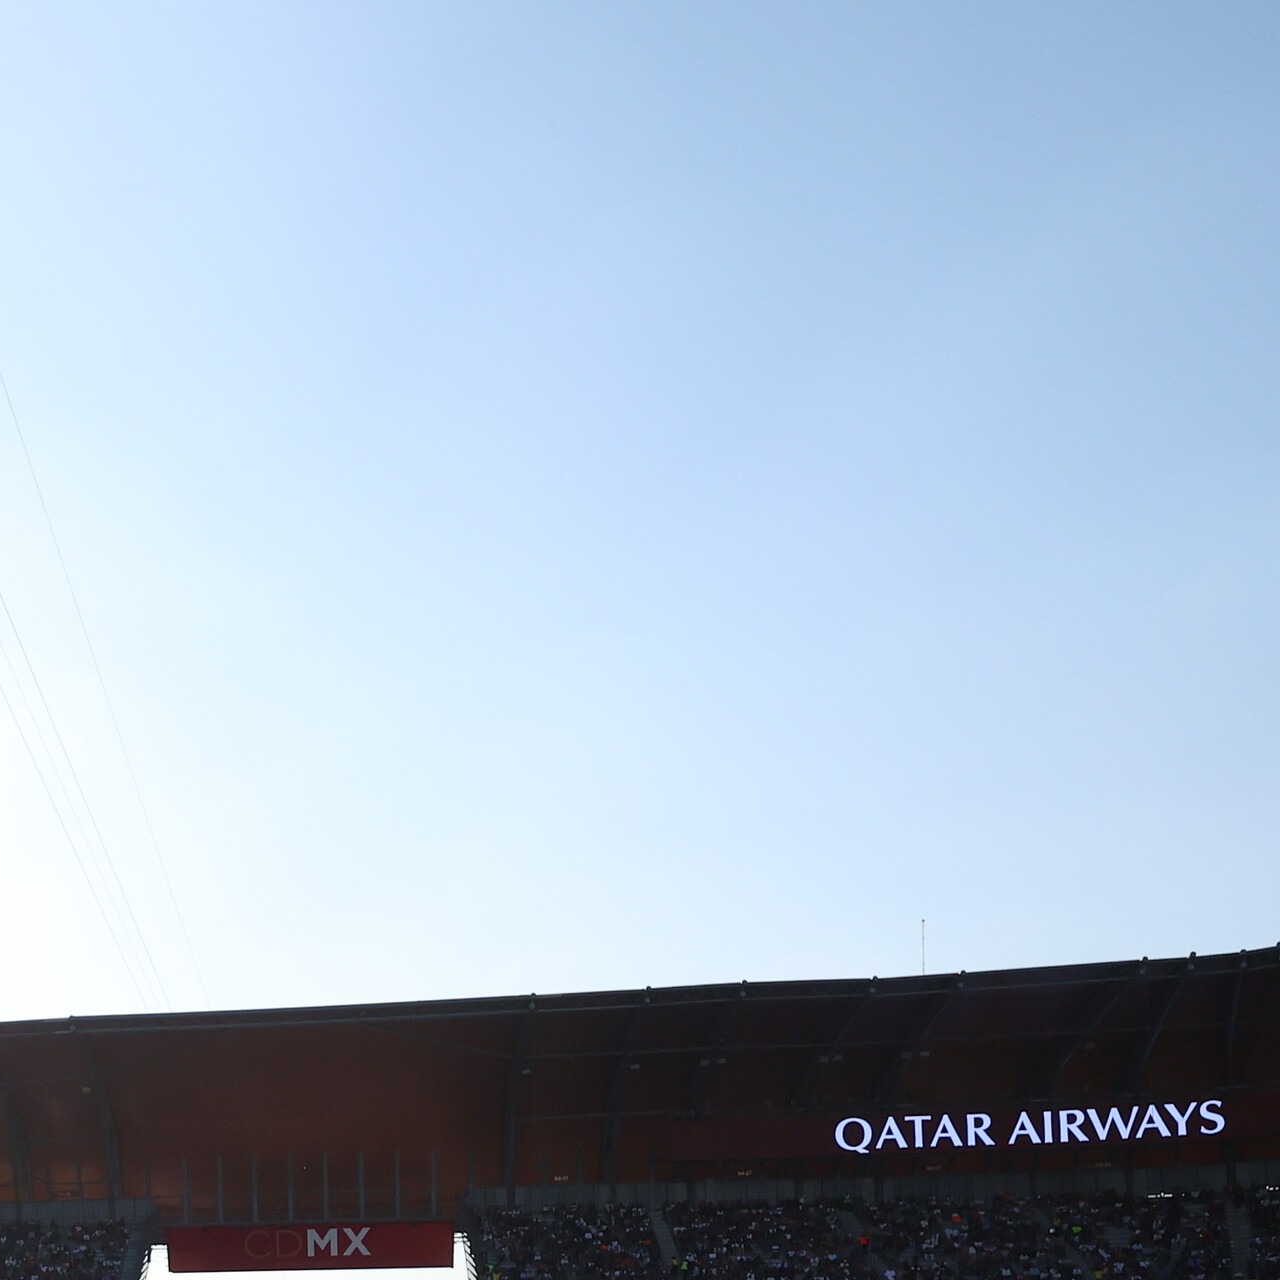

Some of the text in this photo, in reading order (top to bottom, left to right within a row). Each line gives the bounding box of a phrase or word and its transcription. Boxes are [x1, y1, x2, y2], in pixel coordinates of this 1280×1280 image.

[835, 1099, 1226, 1154] QATAR AIRWAYS
[244, 1227, 371, 1258] CDMX
